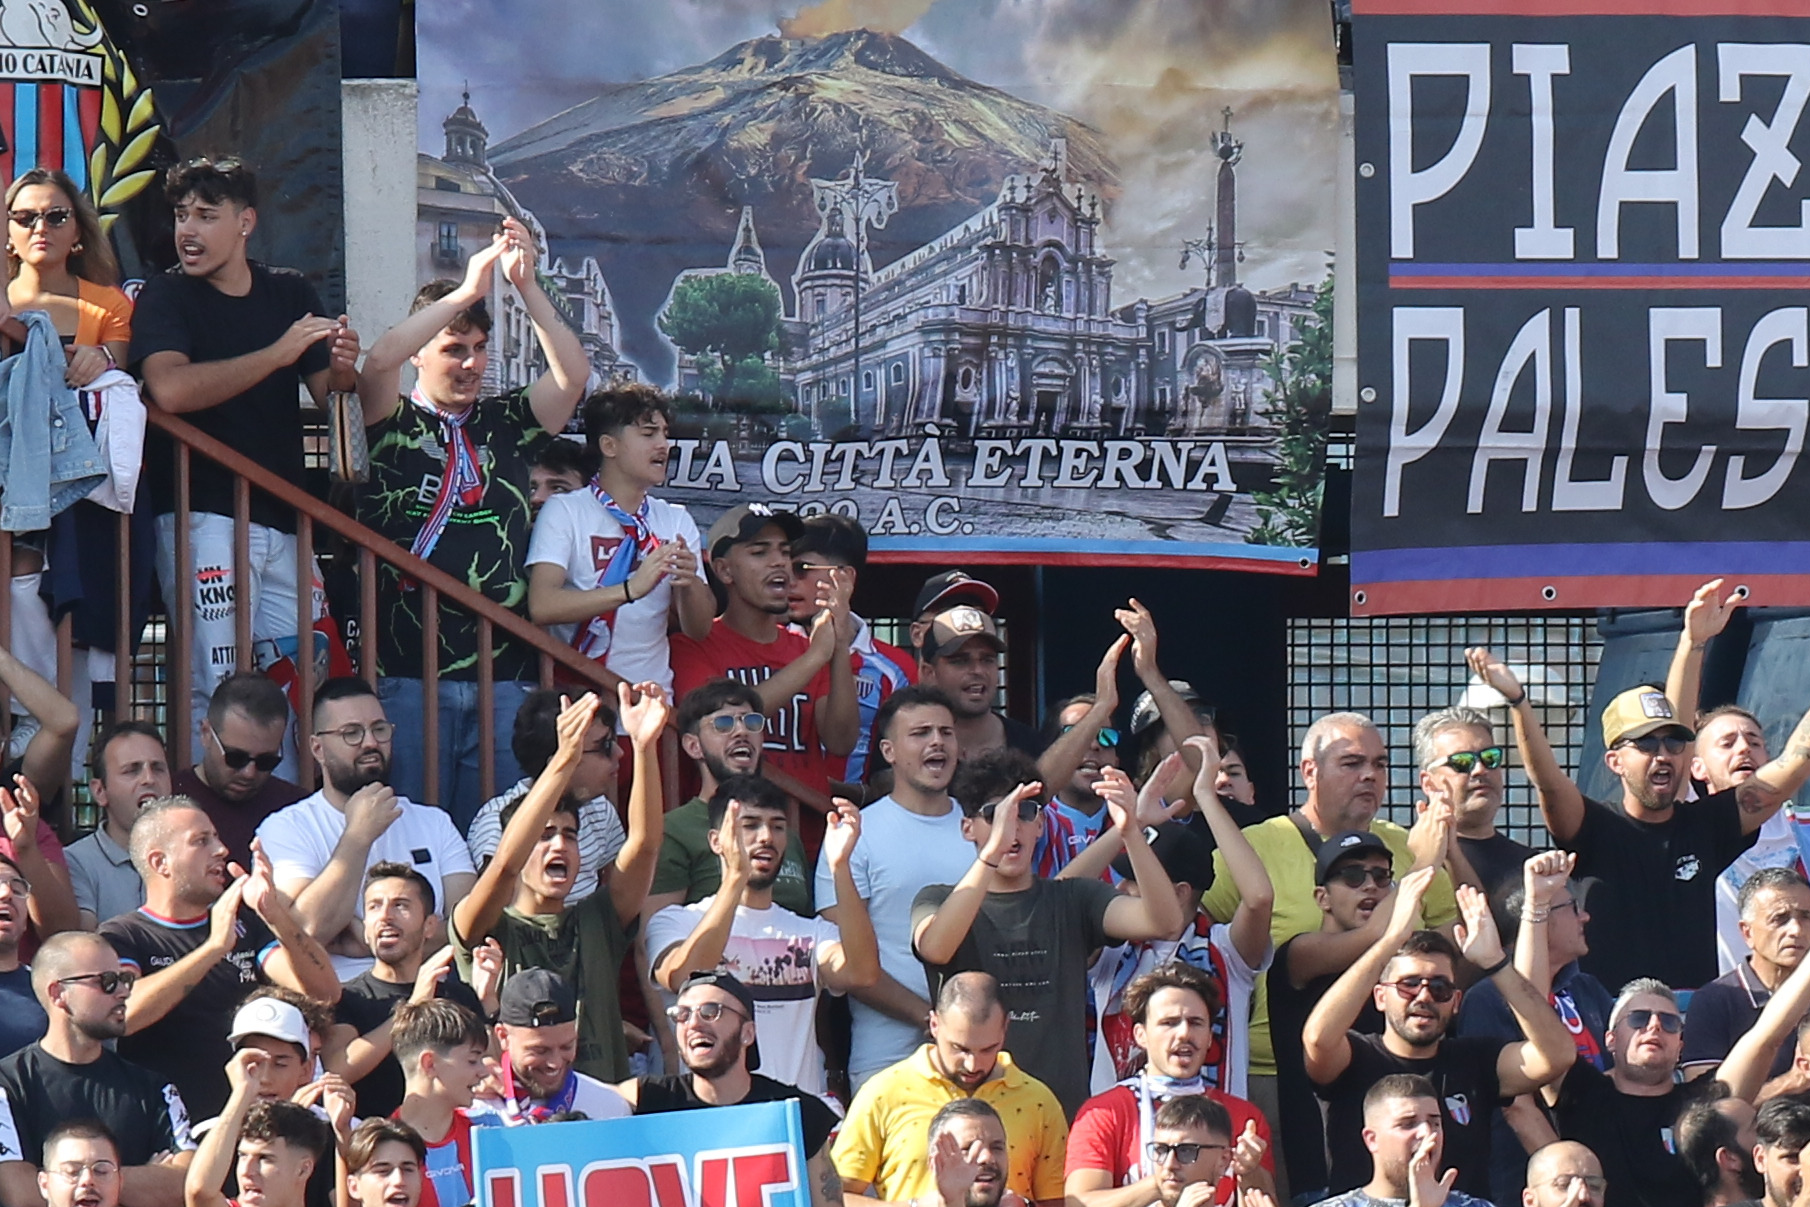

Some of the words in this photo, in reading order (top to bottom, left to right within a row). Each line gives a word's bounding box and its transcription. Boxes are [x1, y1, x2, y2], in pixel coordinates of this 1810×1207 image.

[23, 53, 94, 80] CATANIA
[760, 422, 950, 494] CITTÀ
[967, 438, 1237, 492] ETERNA
